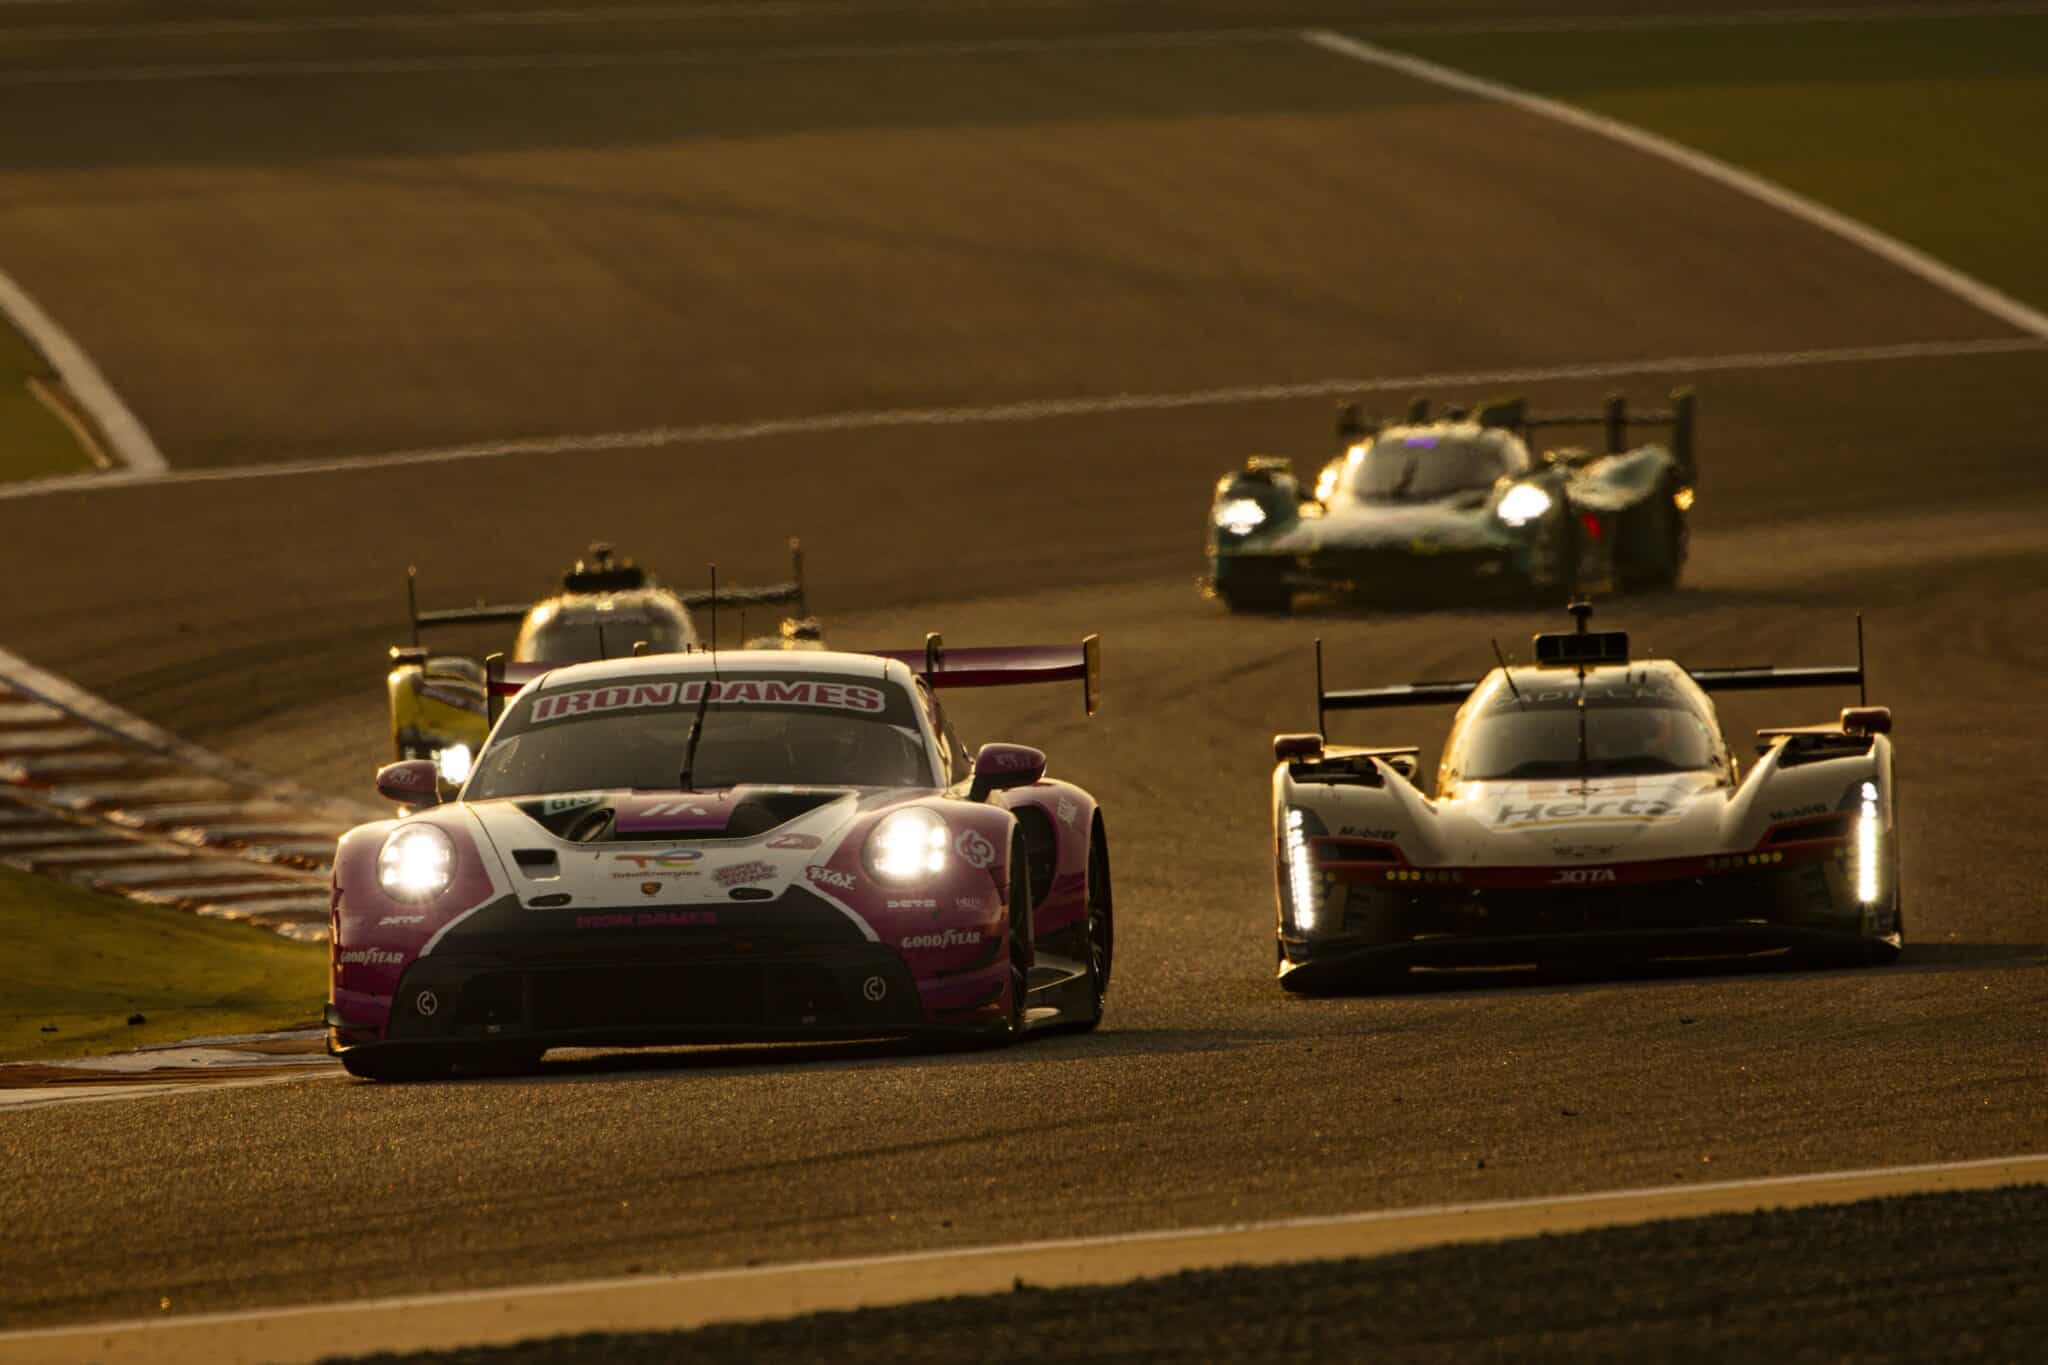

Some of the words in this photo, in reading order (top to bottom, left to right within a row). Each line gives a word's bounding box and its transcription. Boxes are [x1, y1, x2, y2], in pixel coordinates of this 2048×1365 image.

[530, 684, 676, 723] IRON
[680, 680, 884, 712] DAMES
[1495, 799, 1676, 824] Hertz
[1549, 869, 1616, 884] JOTA
[901, 929, 981, 949] GOODYEAR
[340, 947, 404, 967] GOODYEAR
